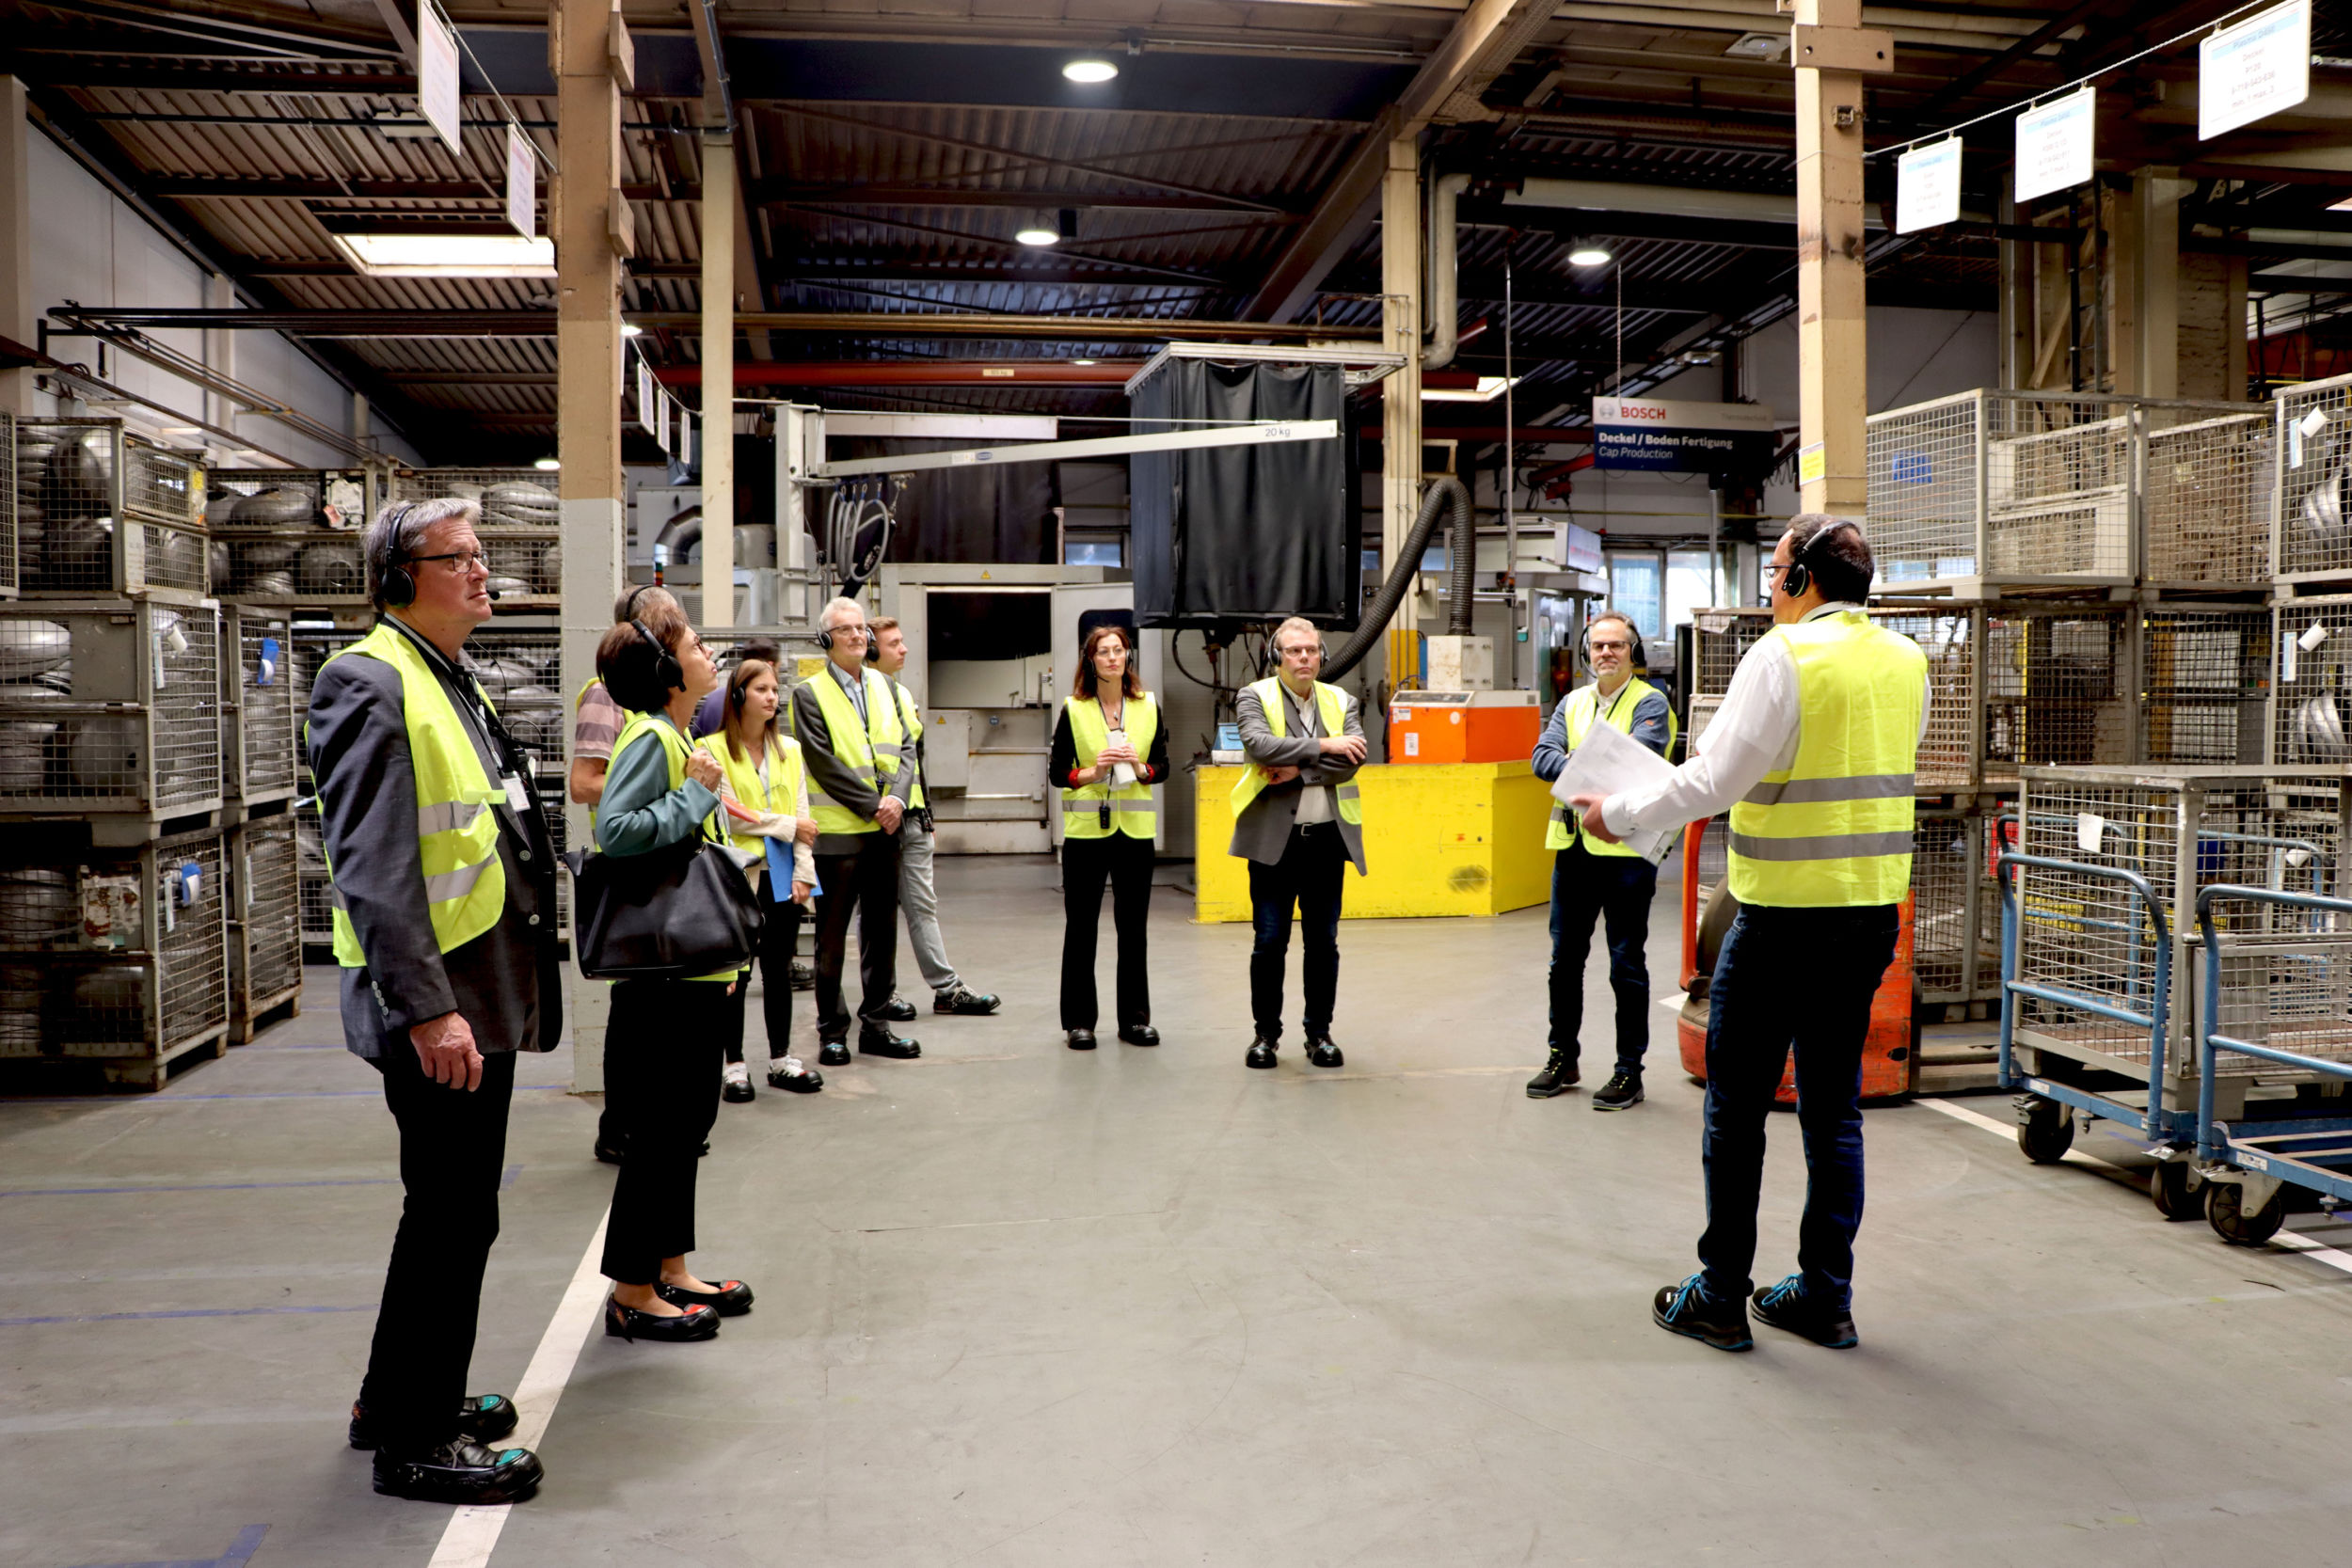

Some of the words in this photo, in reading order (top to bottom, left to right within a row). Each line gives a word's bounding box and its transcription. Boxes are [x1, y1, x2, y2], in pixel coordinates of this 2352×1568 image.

[1621, 406, 1666, 420] BOSCH
[1265, 428, 1278, 437] 20
[1279, 427, 1291, 437] kg
[1598, 432, 1636, 444] Deckel
[1637, 434, 1645, 446] /
[1645, 435, 1680, 445] Boden
[1681, 436, 1734, 450] Fertigung
[1598, 446, 1619, 459] Cap
[1620, 447, 1673, 459] Production
